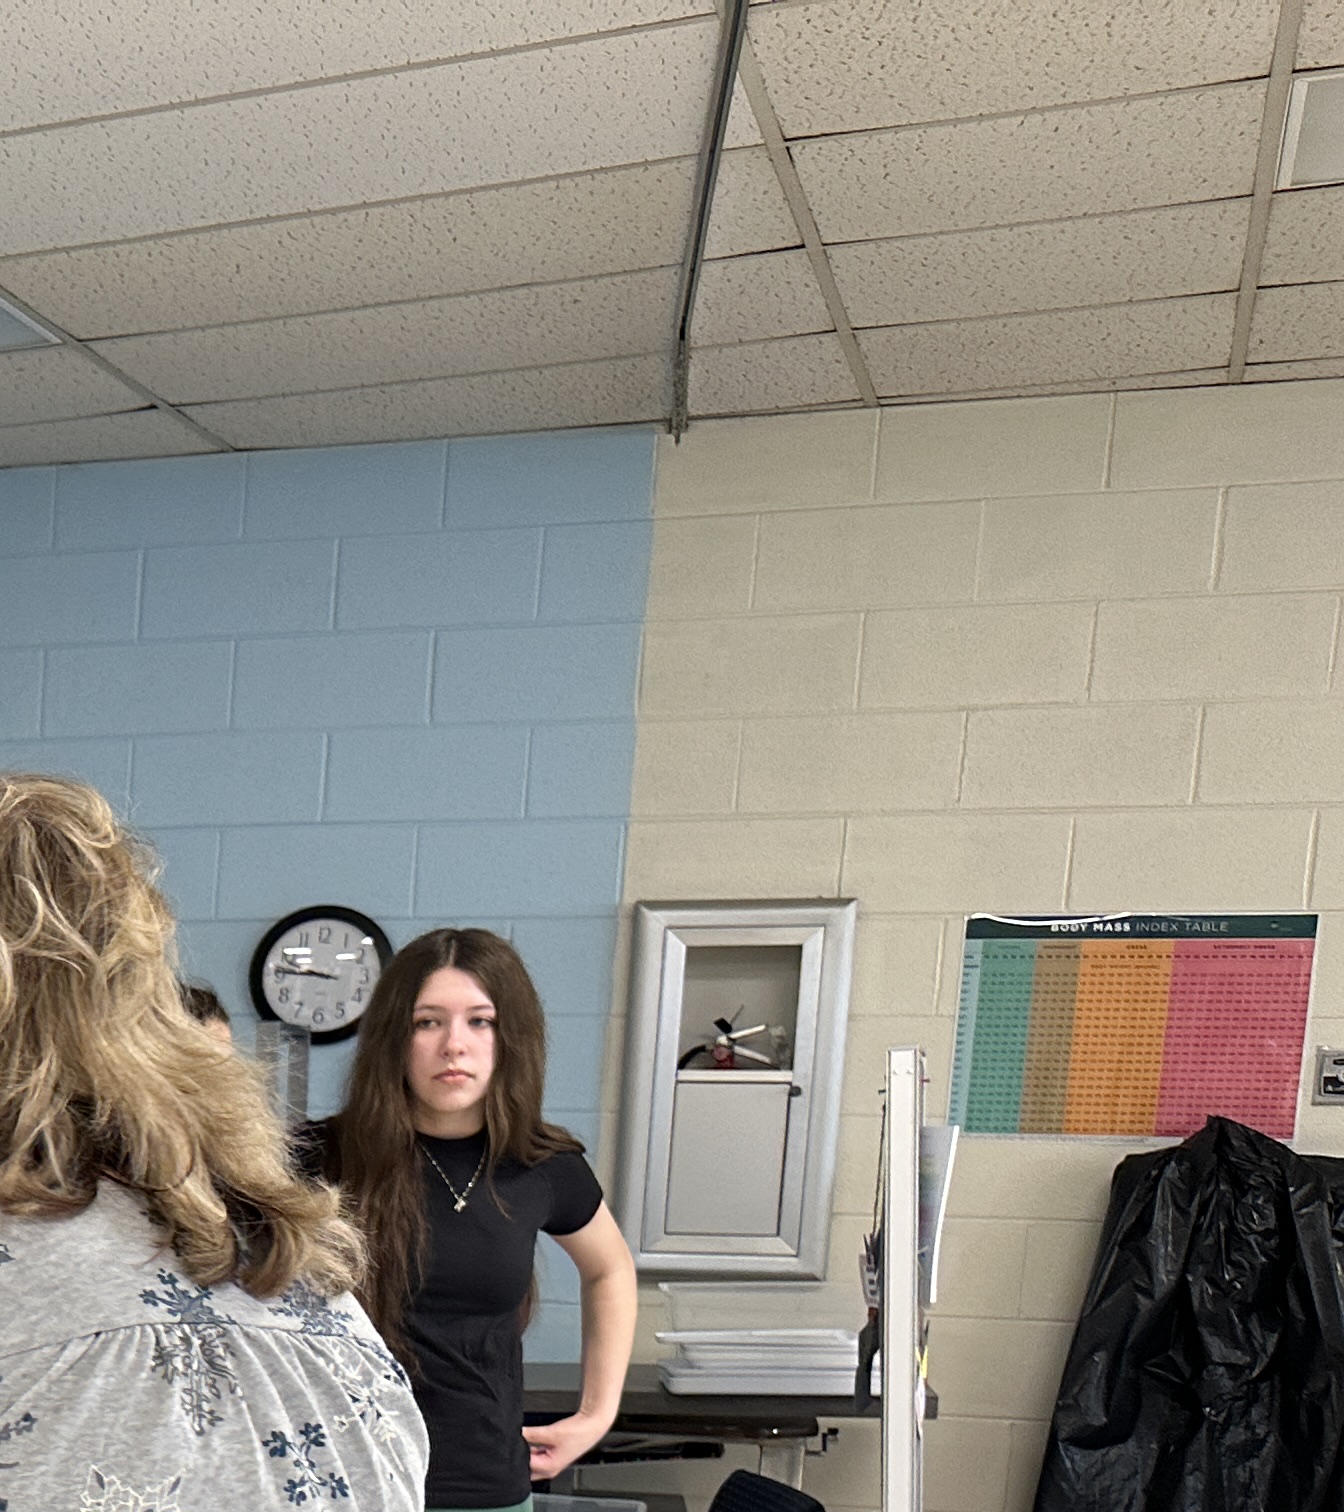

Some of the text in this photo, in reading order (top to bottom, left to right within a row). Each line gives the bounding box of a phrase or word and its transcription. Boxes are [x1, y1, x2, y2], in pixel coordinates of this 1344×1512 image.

[317, 926, 332, 945] 12
[1050, 921, 1229, 933] BODY MASS INDEX TABLE
[359, 967, 370, 985] 3
[277, 986, 291, 1004] 8
[352, 986, 363, 1003] 4
[293, 1001, 304, 1019] 7
[312, 1006, 325, 1025] 6
[334, 1001, 346, 1019] 5
